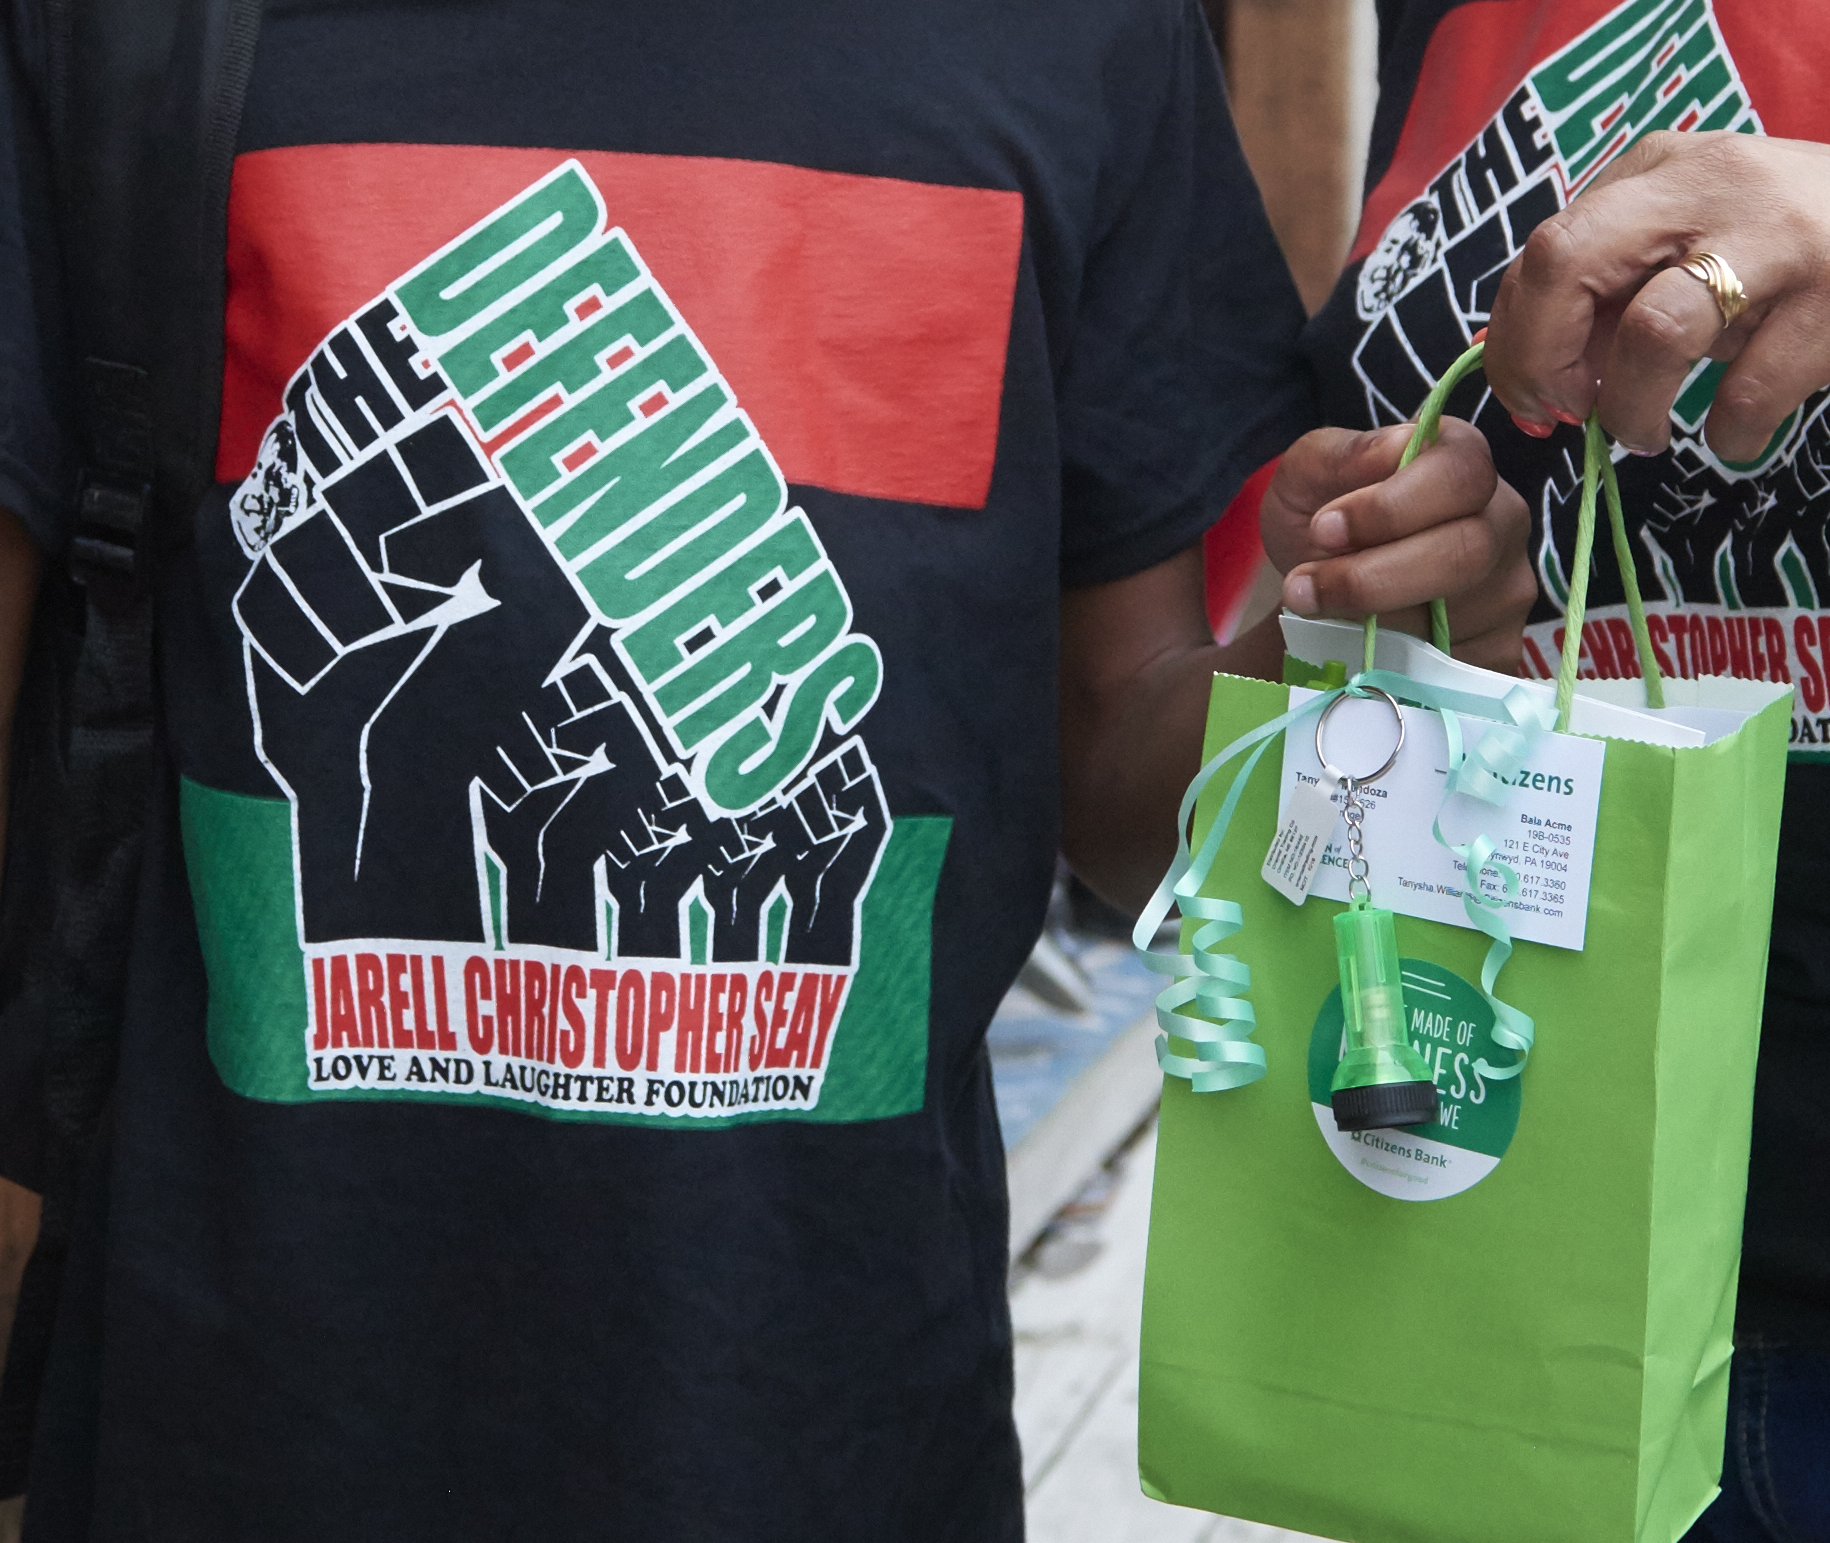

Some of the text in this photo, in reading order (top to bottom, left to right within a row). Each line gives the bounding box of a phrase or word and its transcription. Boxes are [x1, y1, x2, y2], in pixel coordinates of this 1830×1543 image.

[1429, 82, 1555, 242] THE
[285, 297, 449, 479] THE
[392, 164, 881, 814] DEFENDERS
[1521, 814, 1573, 833] Bala Acme
[1503, 839, 1570, 860] 121 E City Ave
[1524, 856, 1538, 868] PA
[311, 952, 848, 1074] JARELL CHRISTOPHER SEAY
[1411, 1007, 1476, 1047] MADE OF
[312, 1054, 815, 1108] LOVE AND LAUGHTER FOUNDATION
[1440, 1101, 1462, 1130] WE
[1363, 1133, 1448, 1168] Citizens Bank
